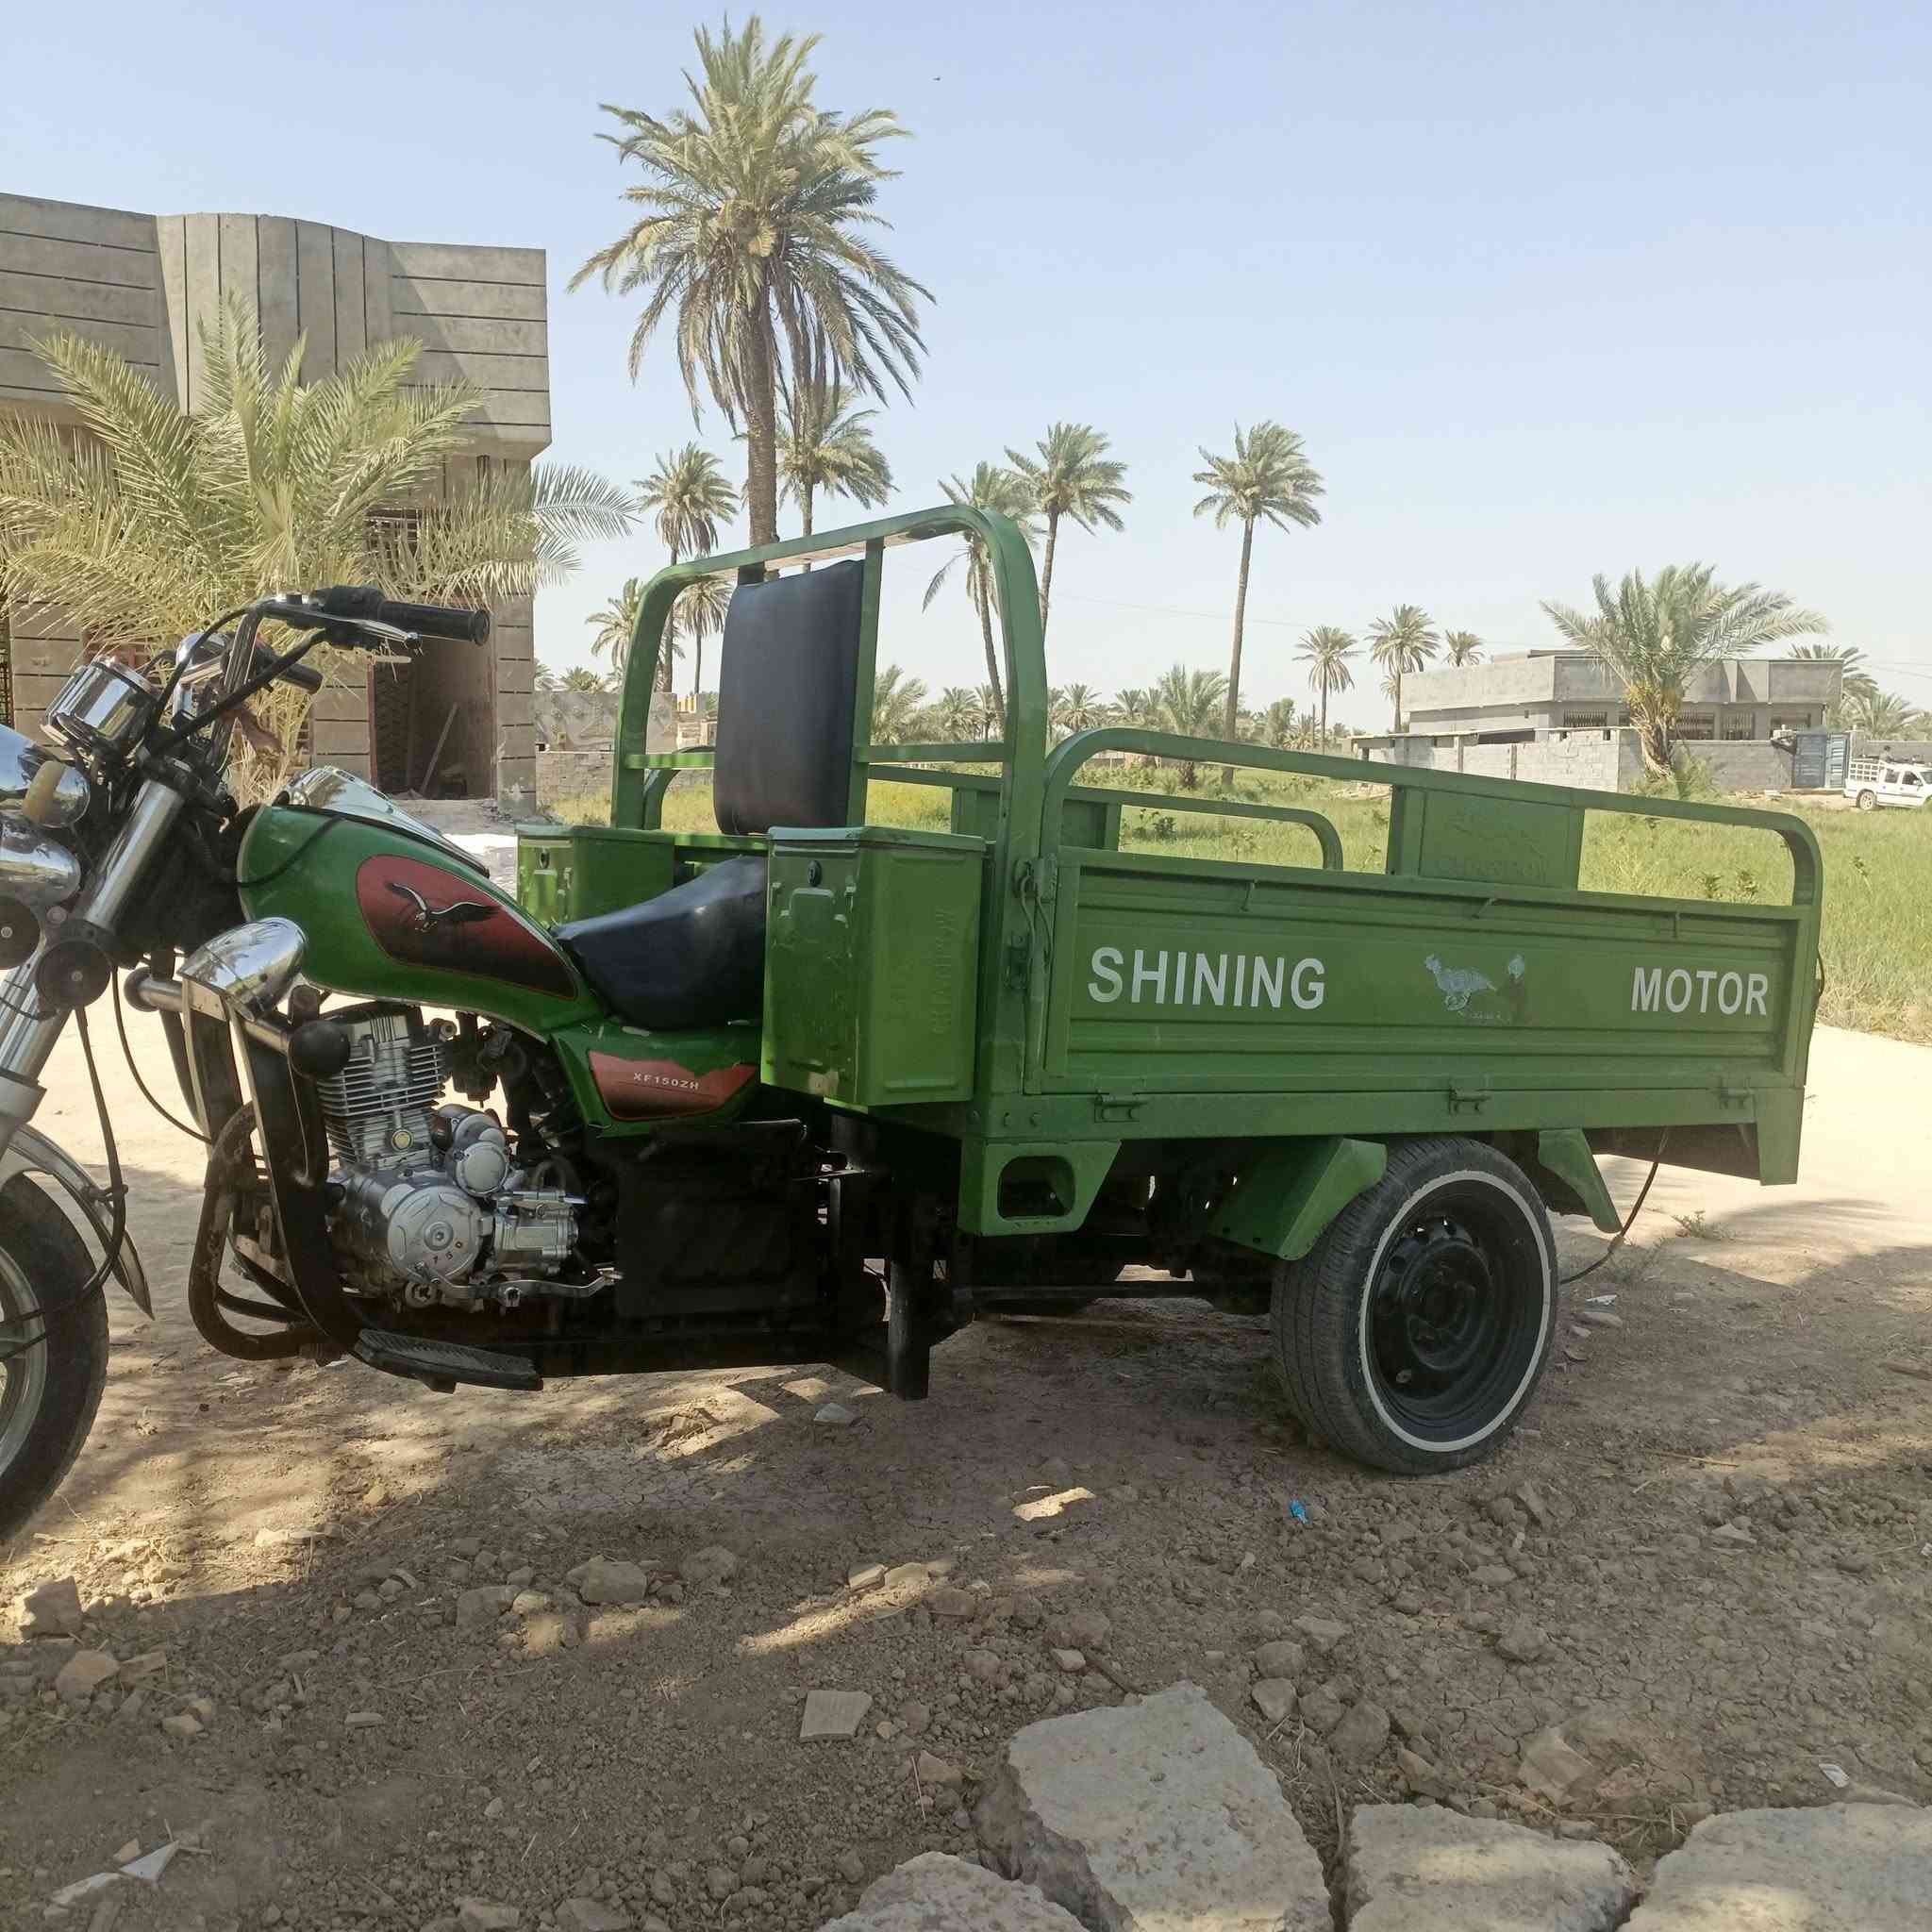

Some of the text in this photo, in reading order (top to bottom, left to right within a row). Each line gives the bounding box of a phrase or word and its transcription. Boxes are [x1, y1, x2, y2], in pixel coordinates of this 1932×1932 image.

[1088, 946, 1768, 1015] SHINING MOTOR
[633, 1072, 699, 1091] XF150ZH
